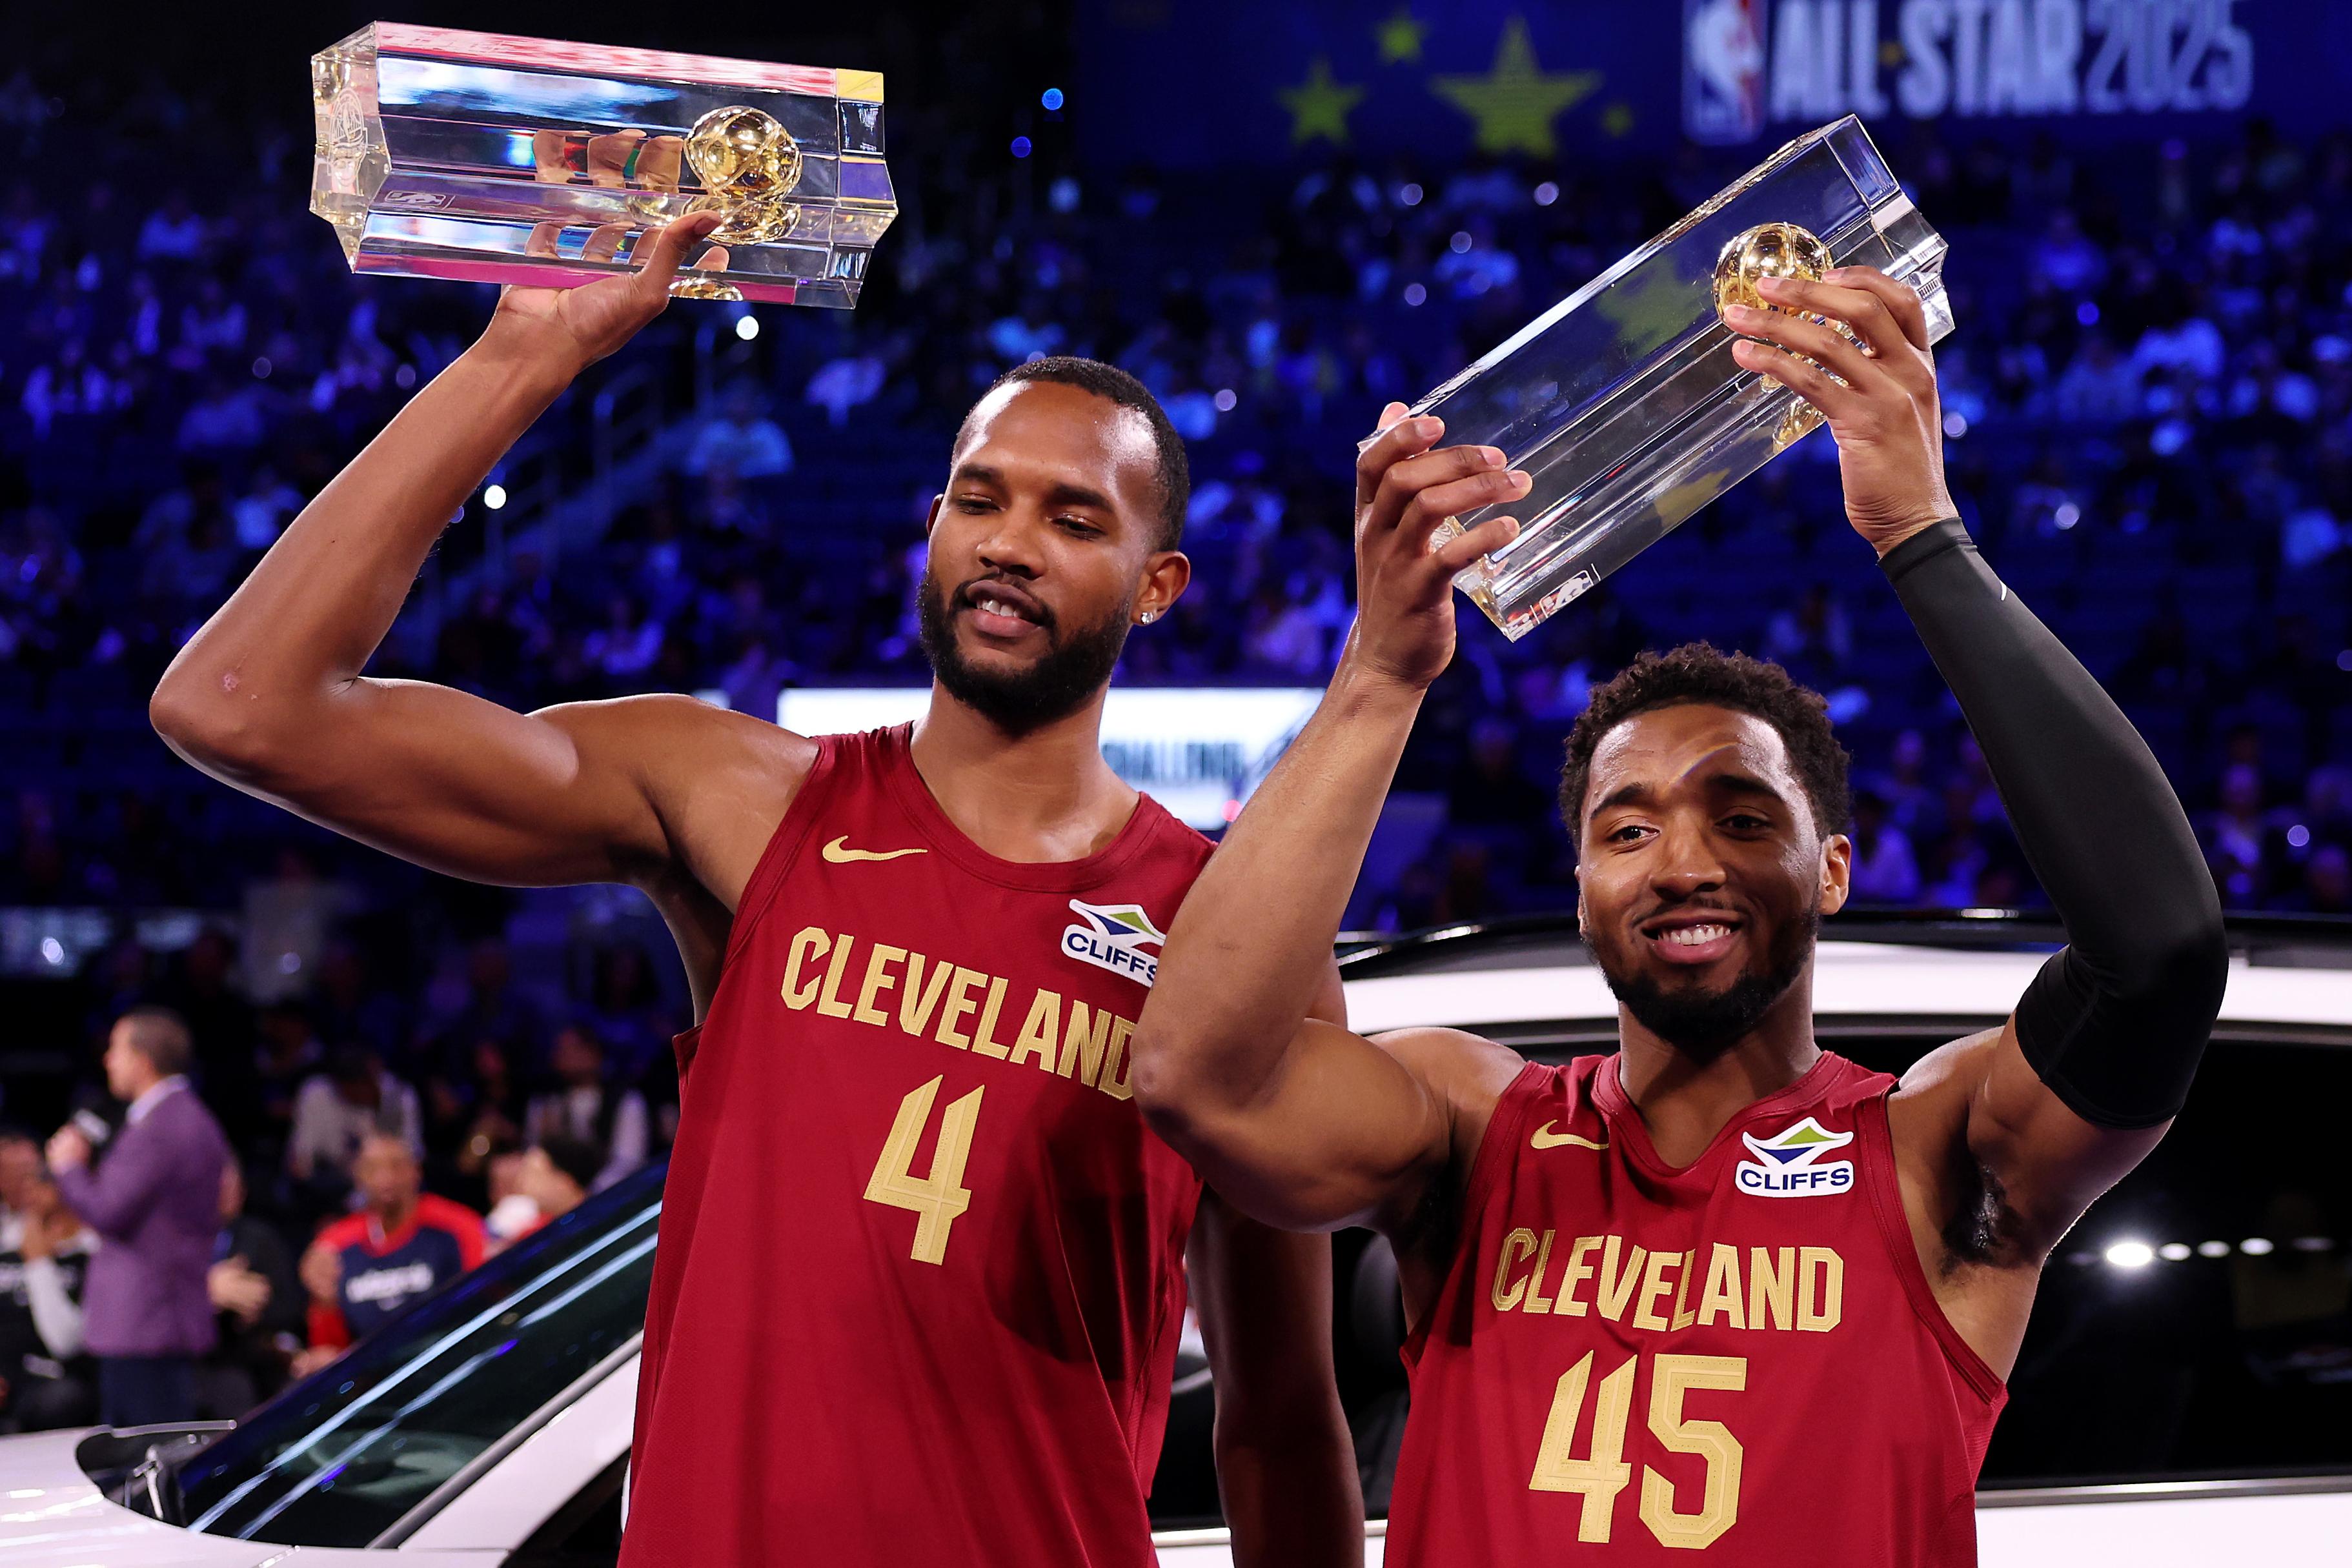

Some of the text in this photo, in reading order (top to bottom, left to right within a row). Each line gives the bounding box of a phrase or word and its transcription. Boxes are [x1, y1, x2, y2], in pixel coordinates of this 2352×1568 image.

[2085, 0, 2254, 114] 2025
[780, 925, 1137, 1101] CLEVELAND
[1067, 933, 1157, 981] CLIFFS
[863, 1074, 986, 1266] 4
[1741, 1167, 1850, 1191] CLIFFS
[1490, 1227, 1845, 1332] CLEVELAND
[1528, 1349, 1747, 1549] 45
